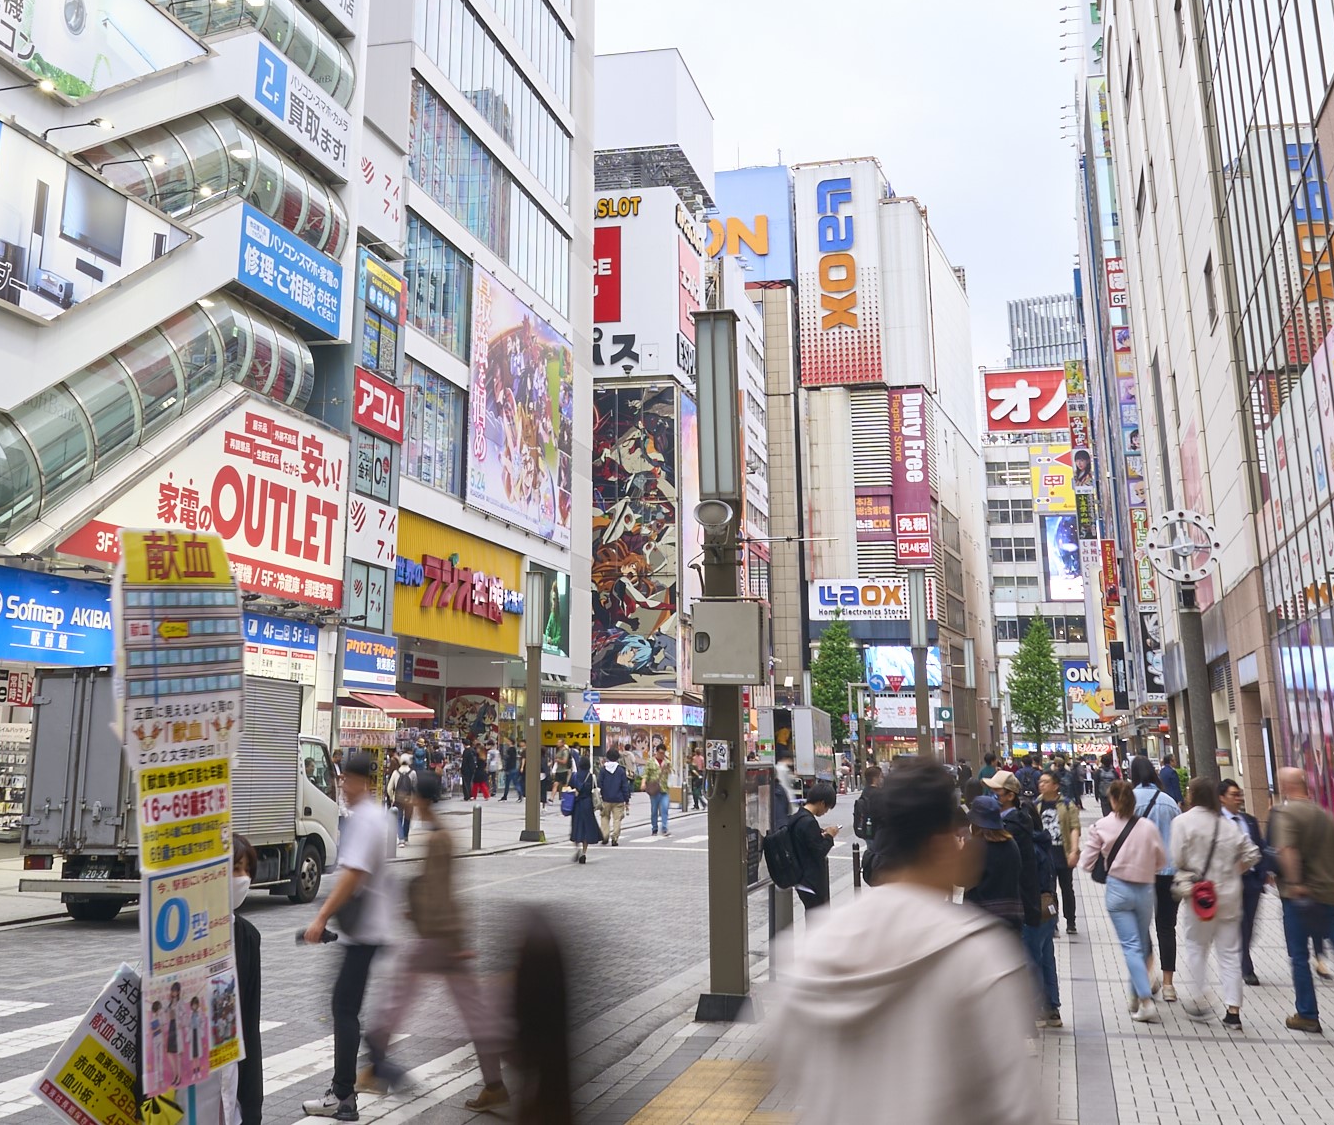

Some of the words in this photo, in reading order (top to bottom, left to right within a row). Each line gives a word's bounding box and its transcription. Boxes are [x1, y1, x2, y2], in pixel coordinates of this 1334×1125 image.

[261, 57, 280, 105] 2F
[597, 196, 642, 218] SLOT
[243, 244, 317, 313] 修理・ご相談
[316, 286, 338, 309] お任せ
[316, 304, 337, 324] ください
[358, 377, 402, 432] アコム
[892, 394, 901, 434] Flagship
[901, 392, 924, 437] Duty
[894, 435, 903, 463] Store
[903, 438, 928, 484] Free
[282, 460, 300, 477] だから
[157, 480, 213, 532] 家電の
[210, 464, 339, 566] OUTLET
[898, 516, 928, 531] 免税
[142, 530, 215, 581] 献血
[395, 555, 425, 587] 世界の
[6, 595, 65, 630] Sofmap
[70, 607, 112, 631] AKIBA
[883, 608, 904, 617] Store
[30, 631, 69, 649] 駅前館
[262, 622, 275, 639] 4F
[291, 626, 303, 643] 5F
[611, 708, 672, 721] AKIHABARA
[566, 731, 596, 740] ライオン
